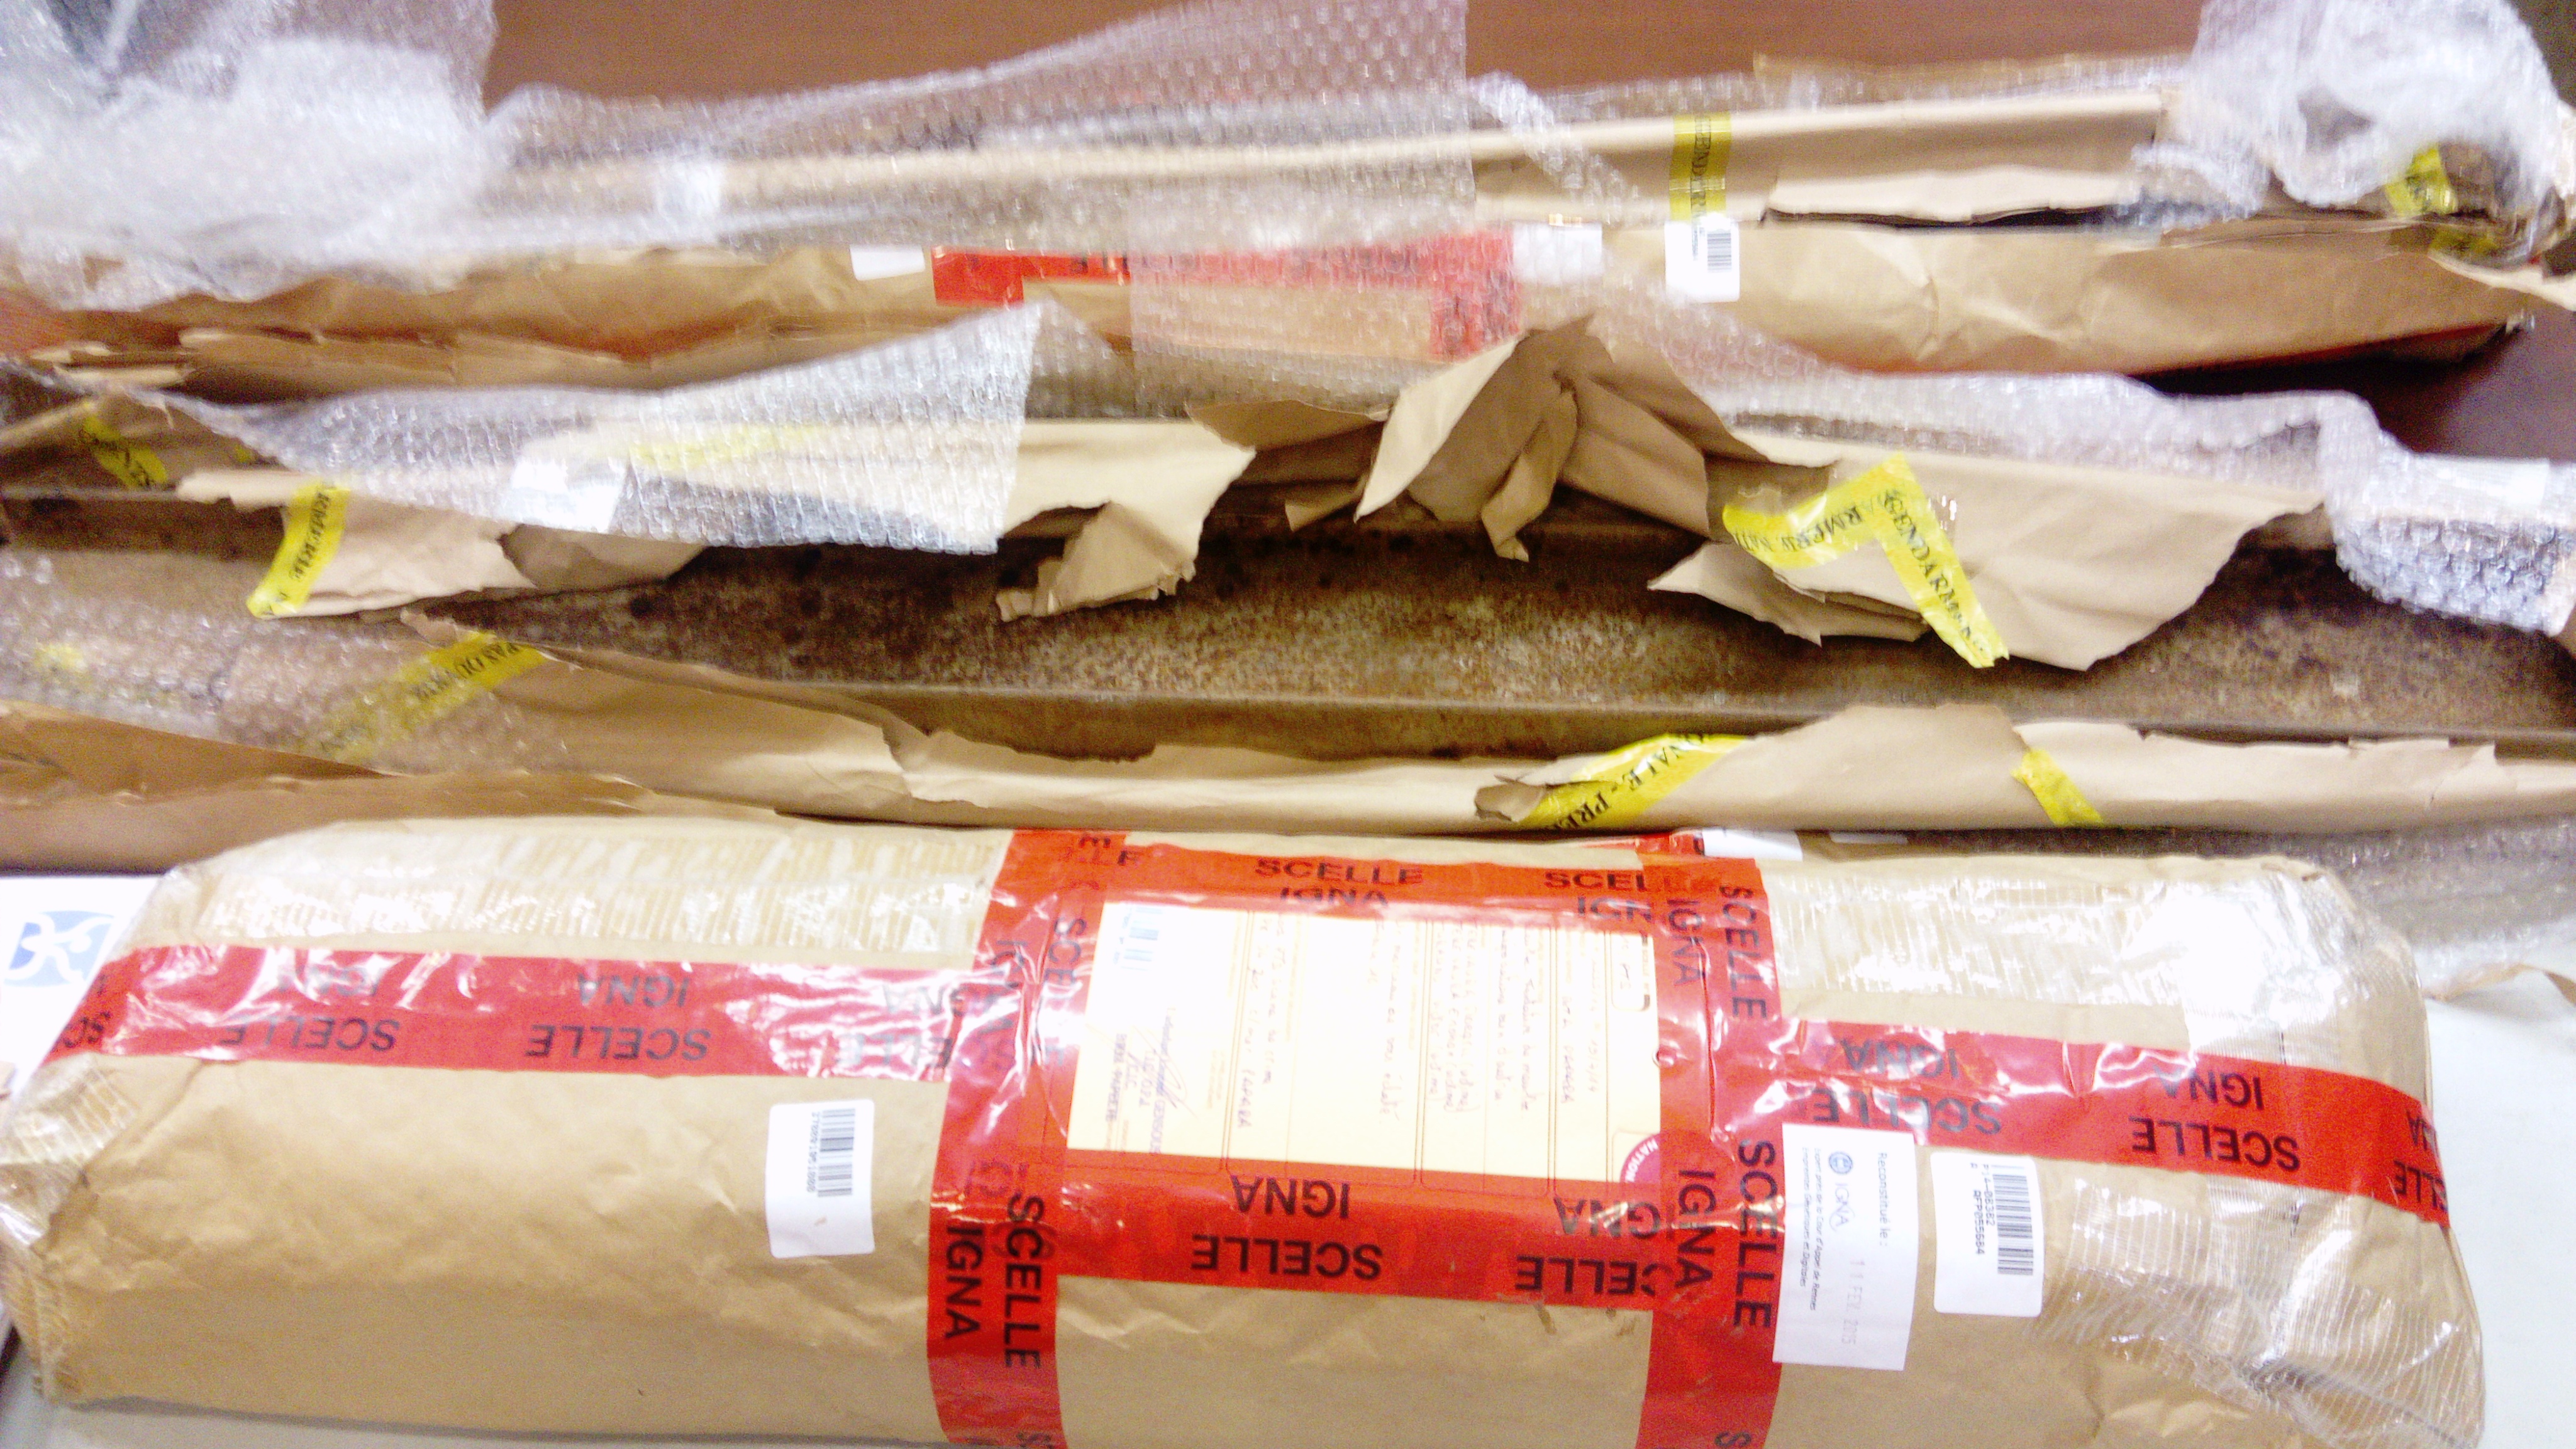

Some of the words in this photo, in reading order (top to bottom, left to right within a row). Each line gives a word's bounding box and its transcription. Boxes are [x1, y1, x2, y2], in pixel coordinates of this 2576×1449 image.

[1255, 858, 1423, 885] SCELLE
[1279, 886, 1389, 907] IGNA
[1577, 896, 1652, 921] IGN
[1666, 899, 1705, 986] IGNA
[1719, 884, 1768, 1018] SCELLE
[576, 973, 690, 1009] IGNA
[219, 1014, 401, 1052] SCELLE
[525, 1023, 713, 1062] SCELLE
[1840, 1038, 1960, 1079] IGNA
[1811, 1086, 2002, 1135] SCELLE
[2152, 1064, 2265, 1111] IGNA
[2128, 1116, 2301, 1172] SCELLE
[1231, 1173, 1351, 1219] IGNA
[1831, 1182, 1852, 1229] IGNA
[1674, 1169, 1716, 1289] IGNA
[1733, 1138, 1779, 1328] SCELLE
[1190, 1232, 1384, 1280] SCELLE
[1516, 1253, 1674, 1297] CELLE
[945, 1224, 984, 1339] IGNA
[1003, 1192, 1045, 1370] SCELLE
